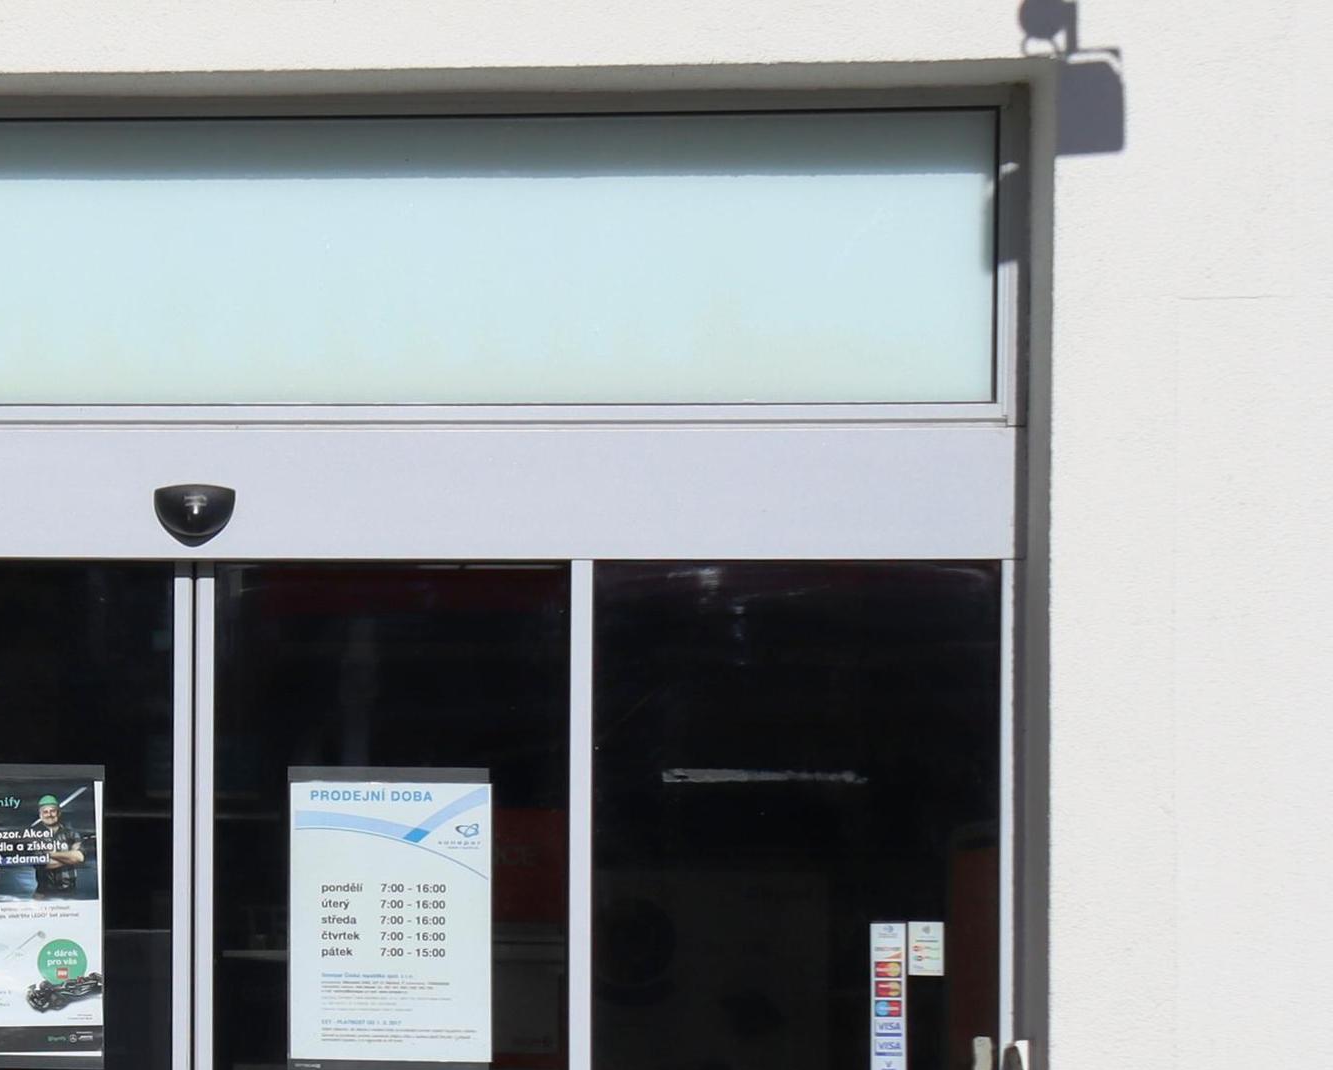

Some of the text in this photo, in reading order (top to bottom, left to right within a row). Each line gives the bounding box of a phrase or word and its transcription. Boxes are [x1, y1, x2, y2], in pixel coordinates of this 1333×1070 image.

[310, 788, 433, 802] PRODEJNÍ DOBA
[23, 828, 53, 839] Akce!
[16, 844, 24, 852] a
[6, 854, 50, 864] zdarma!
[321, 883, 363, 894] pondělí
[380, 884, 404, 892] 7:00
[416, 884, 446, 893] 16:00
[321, 899, 350, 910] úterý
[380, 900, 404, 908] 7:00
[416, 900, 446, 909] 16:00
[321, 915, 357, 925] středa
[380, 916, 404, 925] 7:00
[416, 916, 446, 926] 16:00
[321, 931, 360, 941] čtvrtek
[380, 932, 404, 941] 7:00
[416, 932, 446, 942] 16:00
[54, 949, 78, 957] dárek
[321, 946, 353, 957] pátek
[380, 948, 404, 957] 7:00
[416, 948, 446, 958] 15:00
[879, 1022, 901, 1030] VISA
[879, 1042, 901, 1050] VISA
